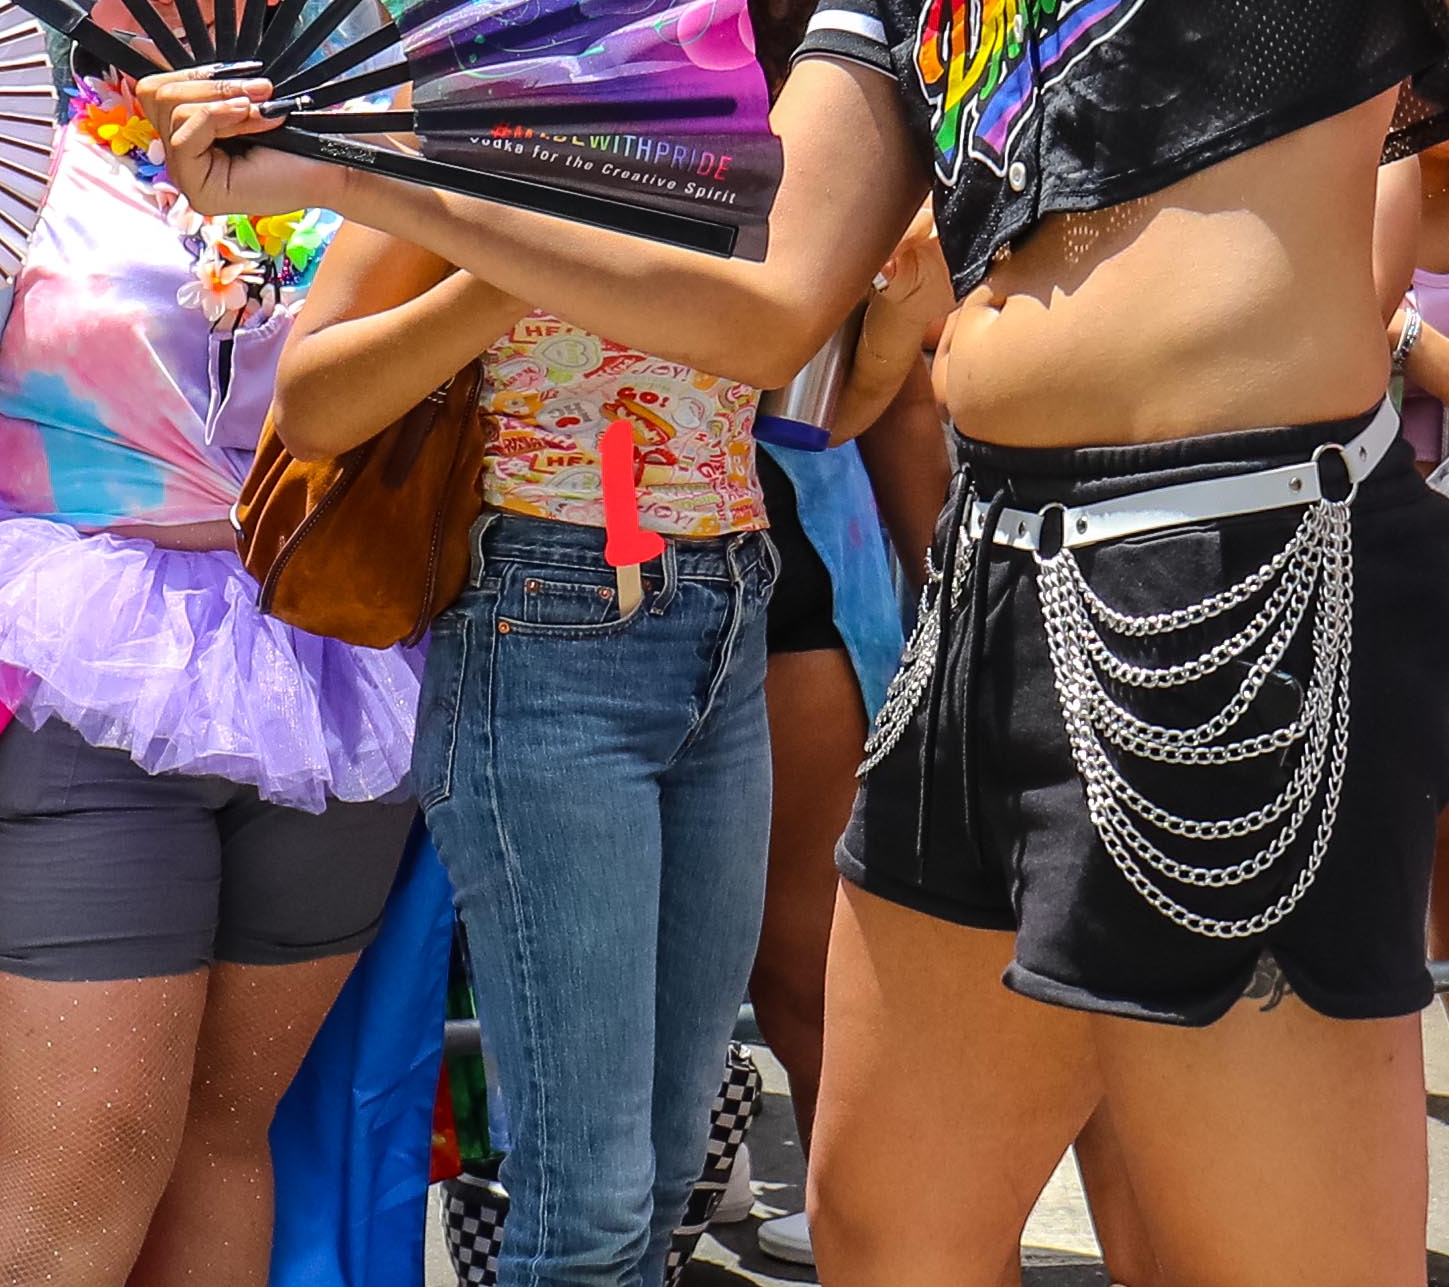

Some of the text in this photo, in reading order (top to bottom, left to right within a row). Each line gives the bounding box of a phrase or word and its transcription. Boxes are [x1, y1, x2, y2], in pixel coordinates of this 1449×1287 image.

[531, 143, 560, 163] for
[565, 153, 594, 171] the
[600, 162, 677, 191] Creative
[683, 181, 738, 205] Spirit
[632, 364, 692, 382] JOY!
